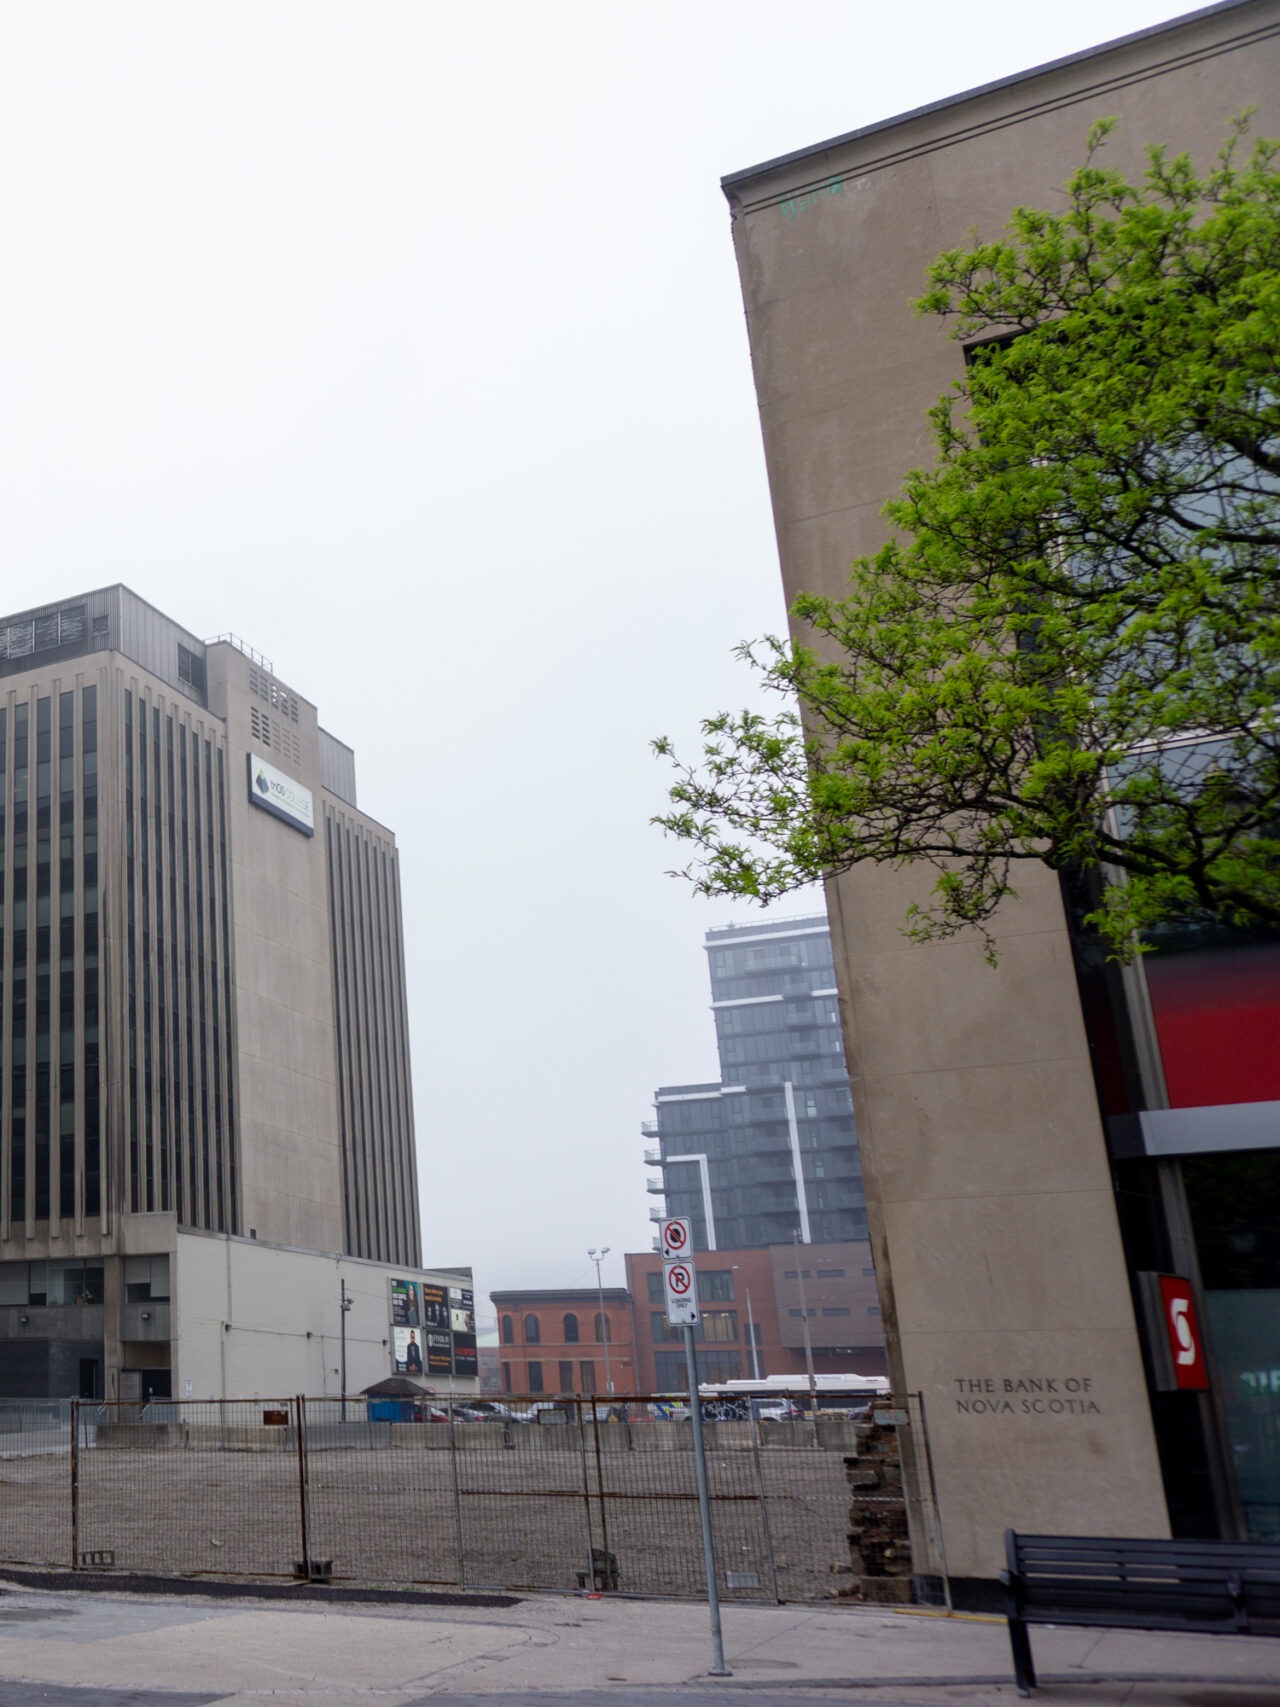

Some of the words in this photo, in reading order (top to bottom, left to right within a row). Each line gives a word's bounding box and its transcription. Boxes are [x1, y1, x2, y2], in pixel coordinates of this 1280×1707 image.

[955, 1378, 995, 1393] THE
[1004, 1378, 1059, 1393] BANK
[1065, 1378, 1093, 1393] OF
[957, 1400, 1015, 1414] NOVA
[1022, 1400, 1100, 1414] SCOTIA
